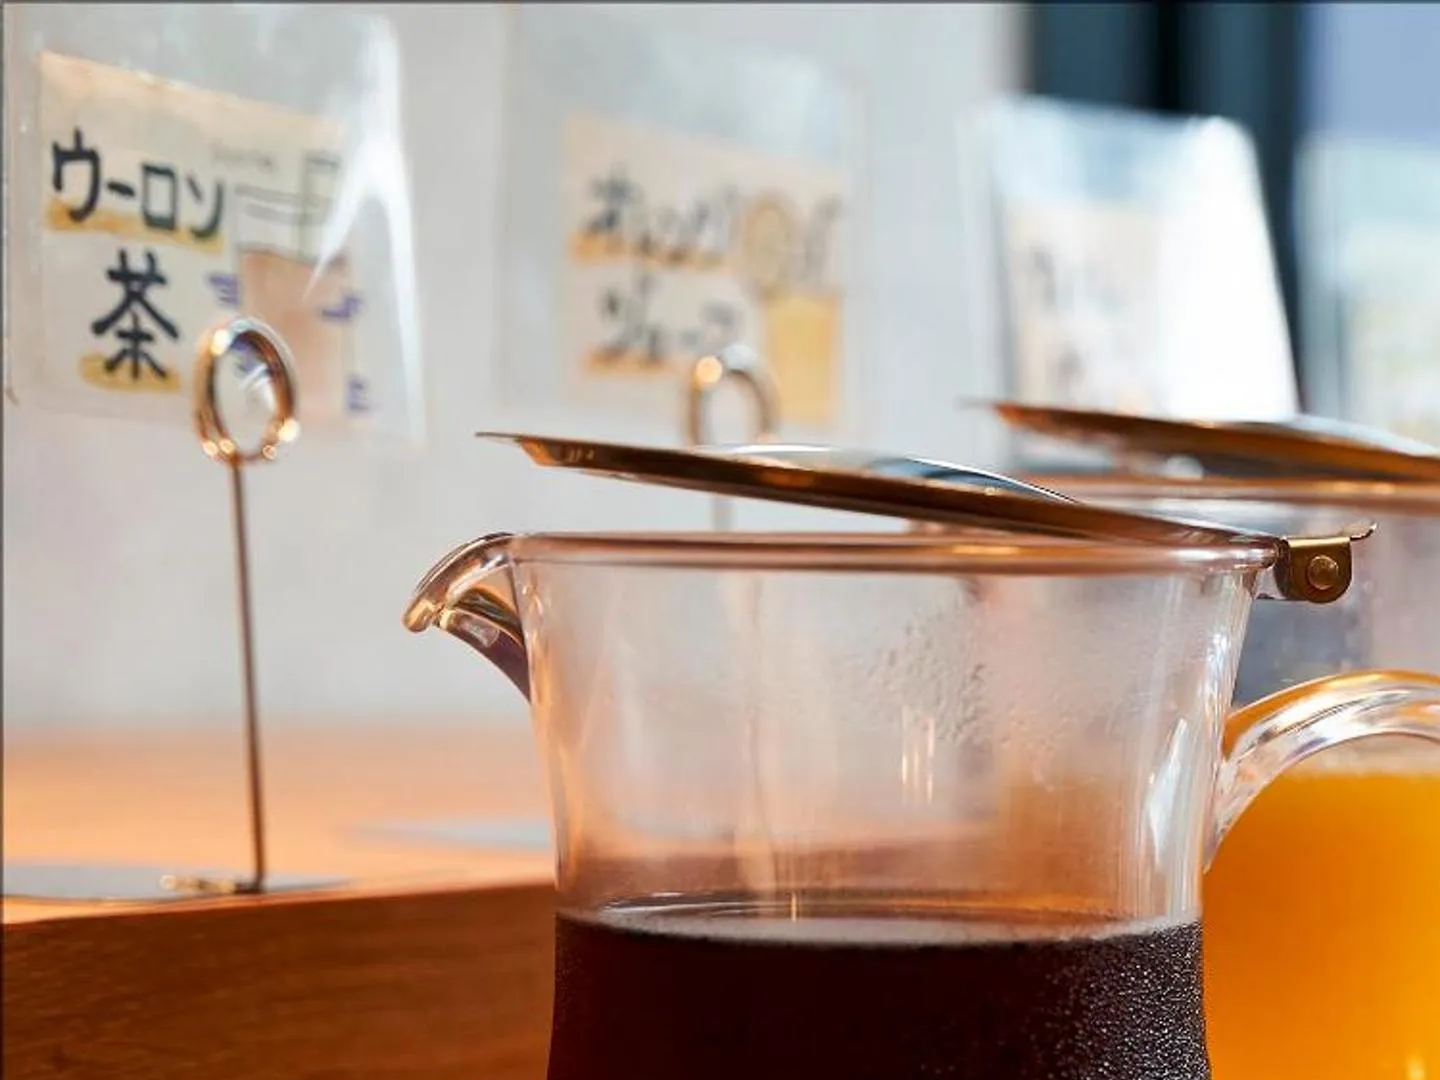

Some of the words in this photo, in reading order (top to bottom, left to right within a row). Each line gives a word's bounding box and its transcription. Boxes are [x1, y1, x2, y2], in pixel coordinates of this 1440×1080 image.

[52, 126, 224, 239] ウーロン
[91, 248, 181, 380] 茶
